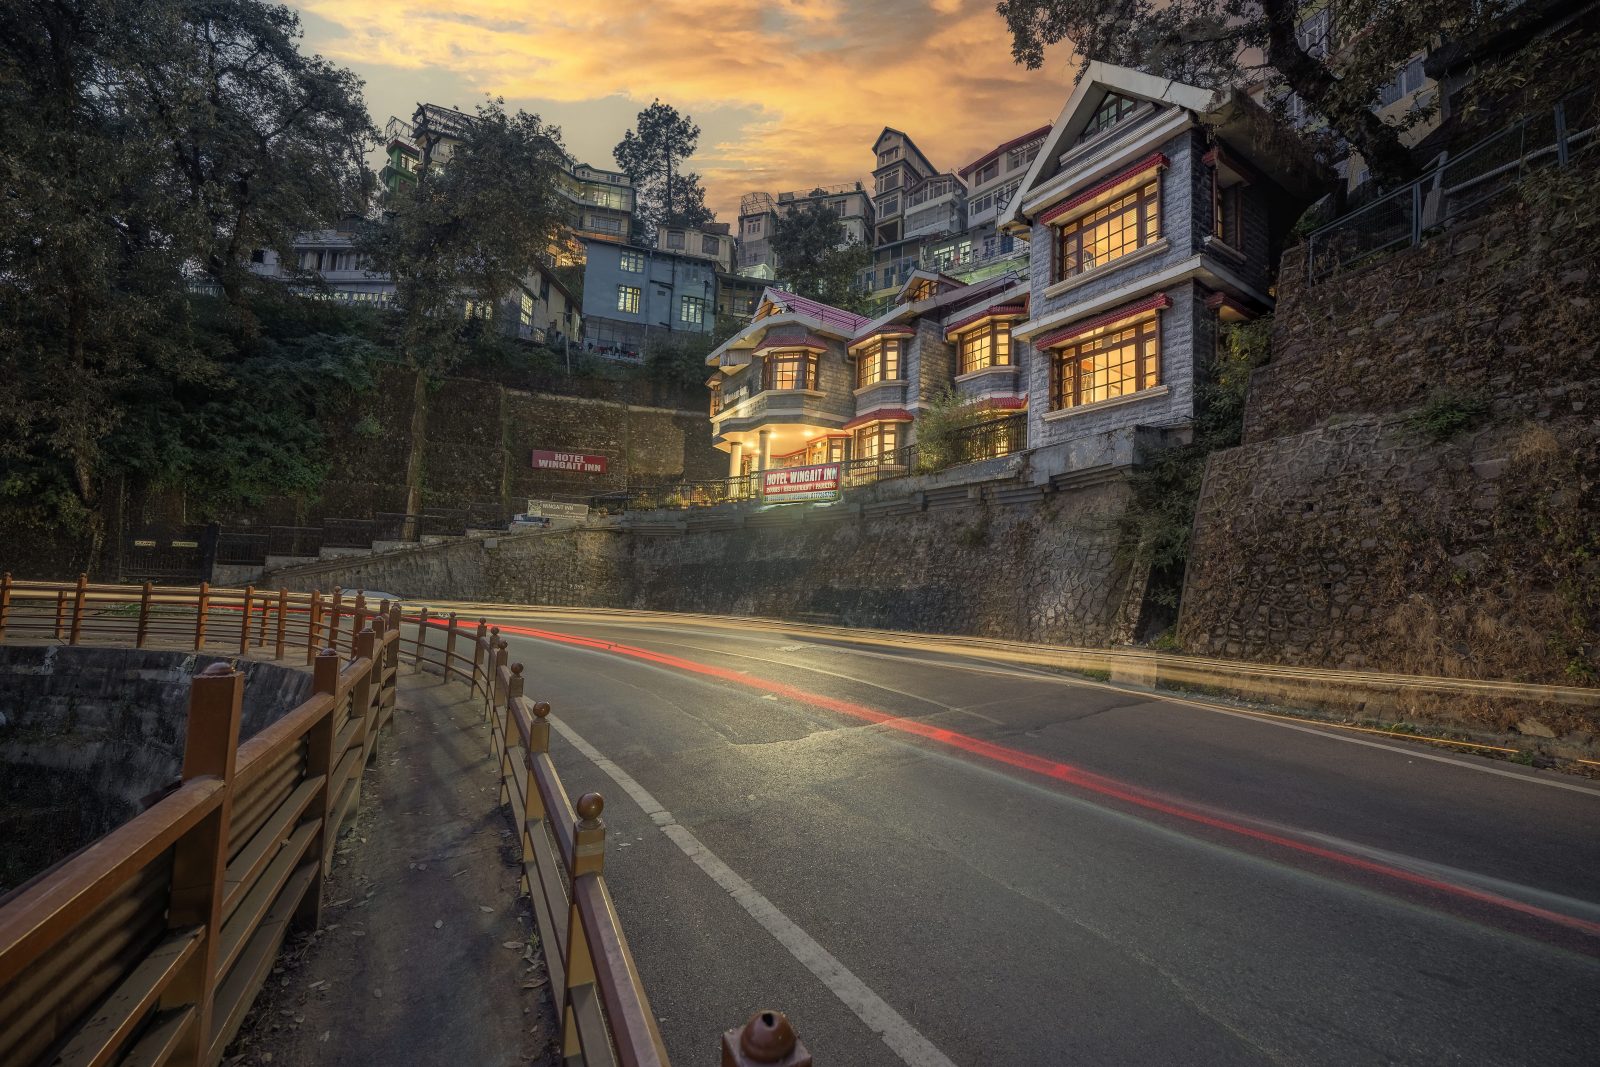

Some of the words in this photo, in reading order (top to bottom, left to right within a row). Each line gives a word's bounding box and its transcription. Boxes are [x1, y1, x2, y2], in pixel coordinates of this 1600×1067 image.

[554, 453, 585, 463] HOTEL
[538, 459, 582, 470] WINGAIT
[584, 464, 601, 472] INN
[767, 473, 788, 486] HOTEL
[790, 468, 822, 483] WINGAIT
[824, 467, 838, 480] INN
